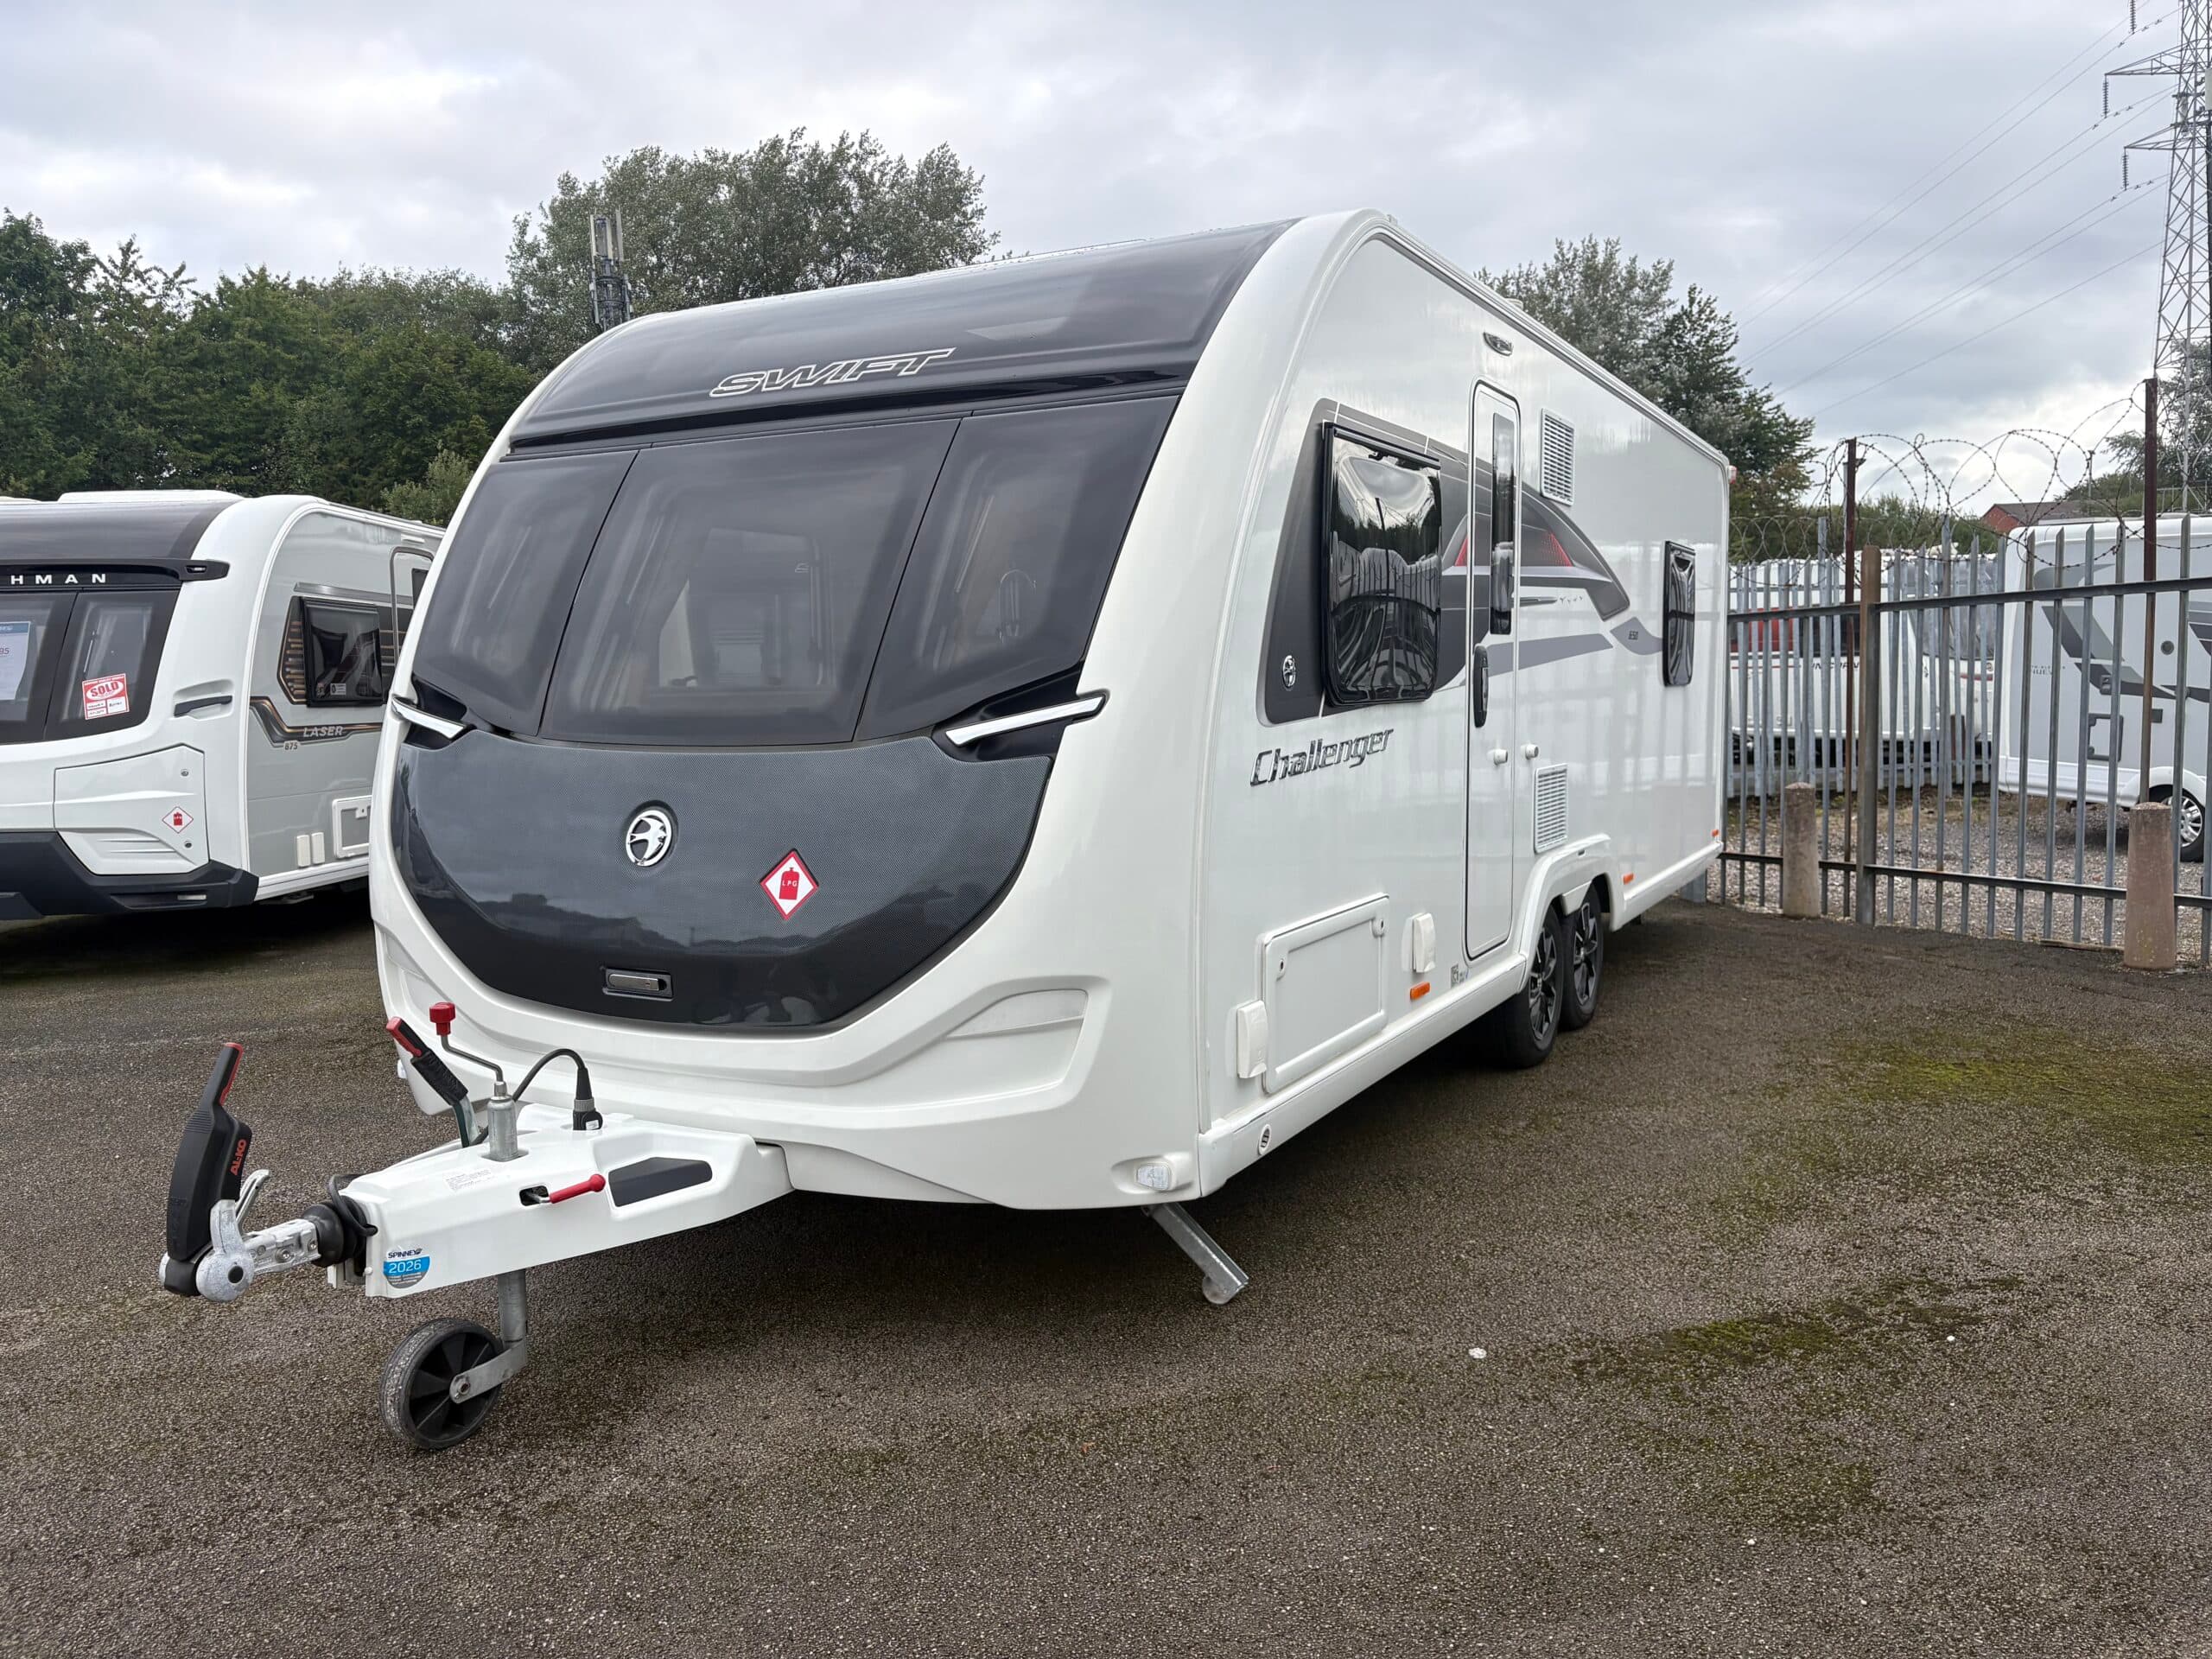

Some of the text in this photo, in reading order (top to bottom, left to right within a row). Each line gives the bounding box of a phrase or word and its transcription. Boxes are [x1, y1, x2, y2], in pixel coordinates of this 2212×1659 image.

[709, 347, 957, 397] SWIFT
[91, 682, 119, 696] SOLD
[303, 726, 343, 738] LASER
[1250, 728, 1394, 786] Challenger
[389, 1259, 422, 1274] 2026
